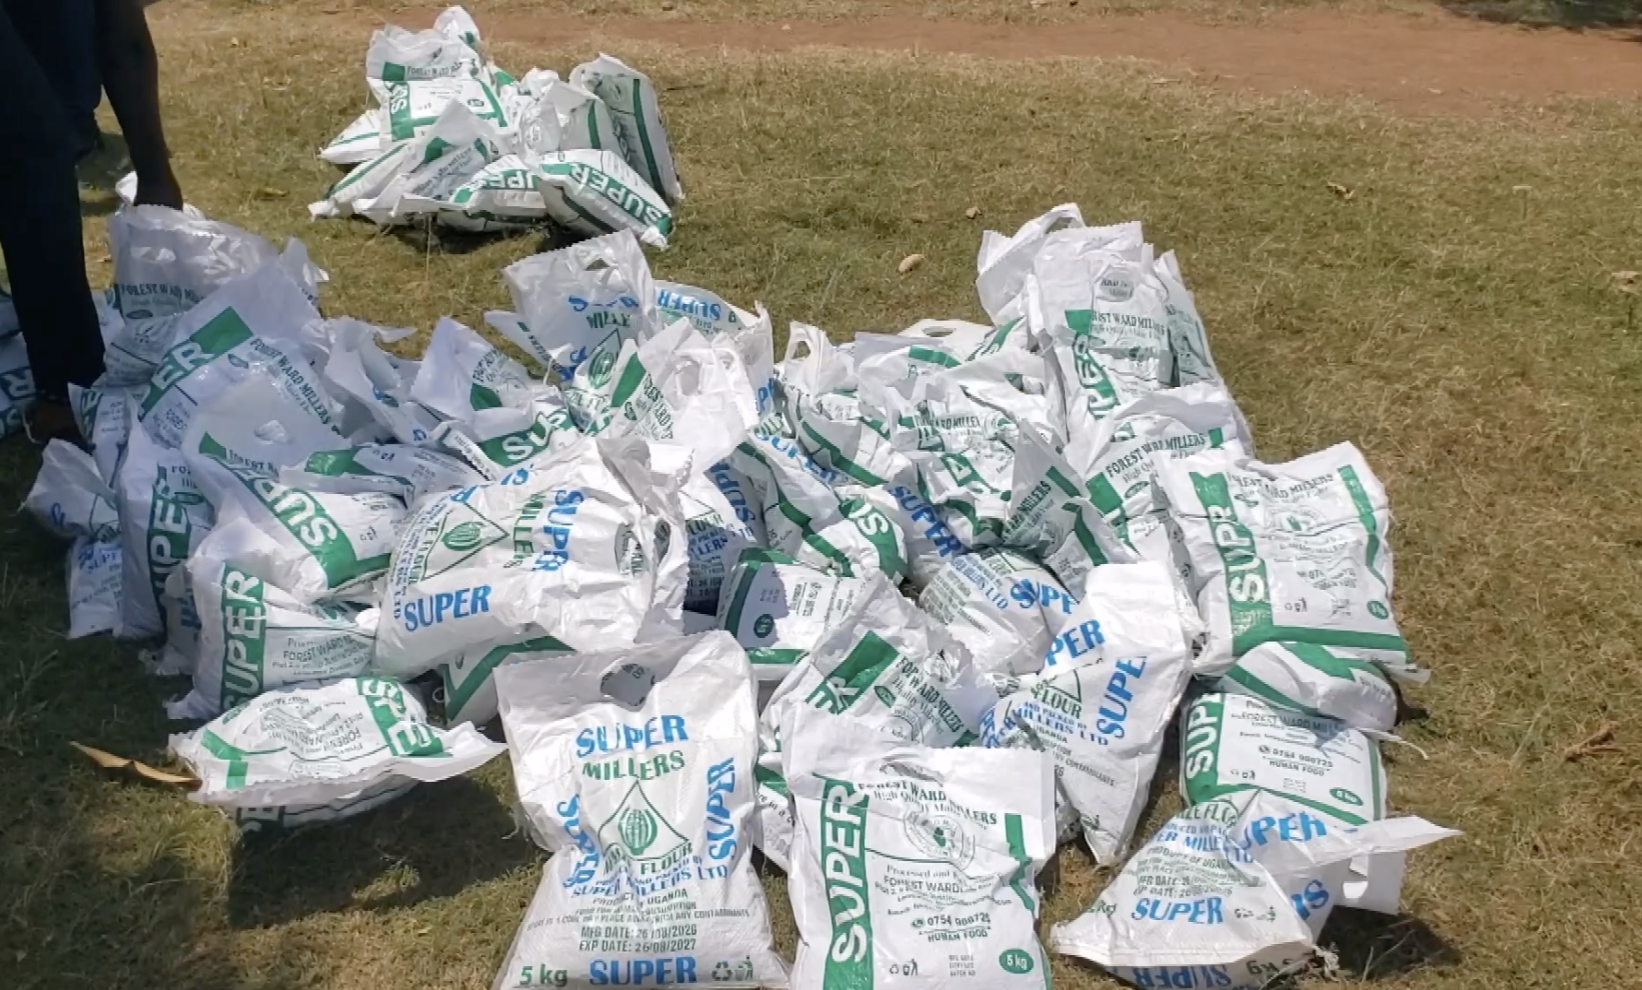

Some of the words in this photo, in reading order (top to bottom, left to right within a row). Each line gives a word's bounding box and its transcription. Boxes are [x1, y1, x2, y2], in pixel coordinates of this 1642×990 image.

[403, 584, 491, 632] SUPER
[576, 714, 690, 759] SUPER
[582, 749, 686, 781] MILLERS
[1269, 760, 1300, 772] HUMAN
[909, 783, 947, 801] WARD
[706, 757, 738, 860] SUPER
[640, 841, 695, 875] FLOUR
[696, 864, 729, 881] LTD
[825, 784, 869, 964] SUPER
[924, 876, 961, 893] WARD
[646, 888, 689, 905] UGANDA
[926, 911, 952, 927] 0754
[1131, 897, 1224, 924] SUPER
[580, 925, 600, 938] MFG
[926, 930, 961, 943] HUMAN
[962, 928, 989, 940] FOOD
[579, 939, 599, 952] EXP
[600, 939, 633, 953] DATE:
[588, 955, 698, 986] SUPER
[1006, 955, 1013, 967] 5
[1014, 954, 1028, 970] kg
[519, 965, 534, 986] 5
[539, 963, 568, 987] kg
